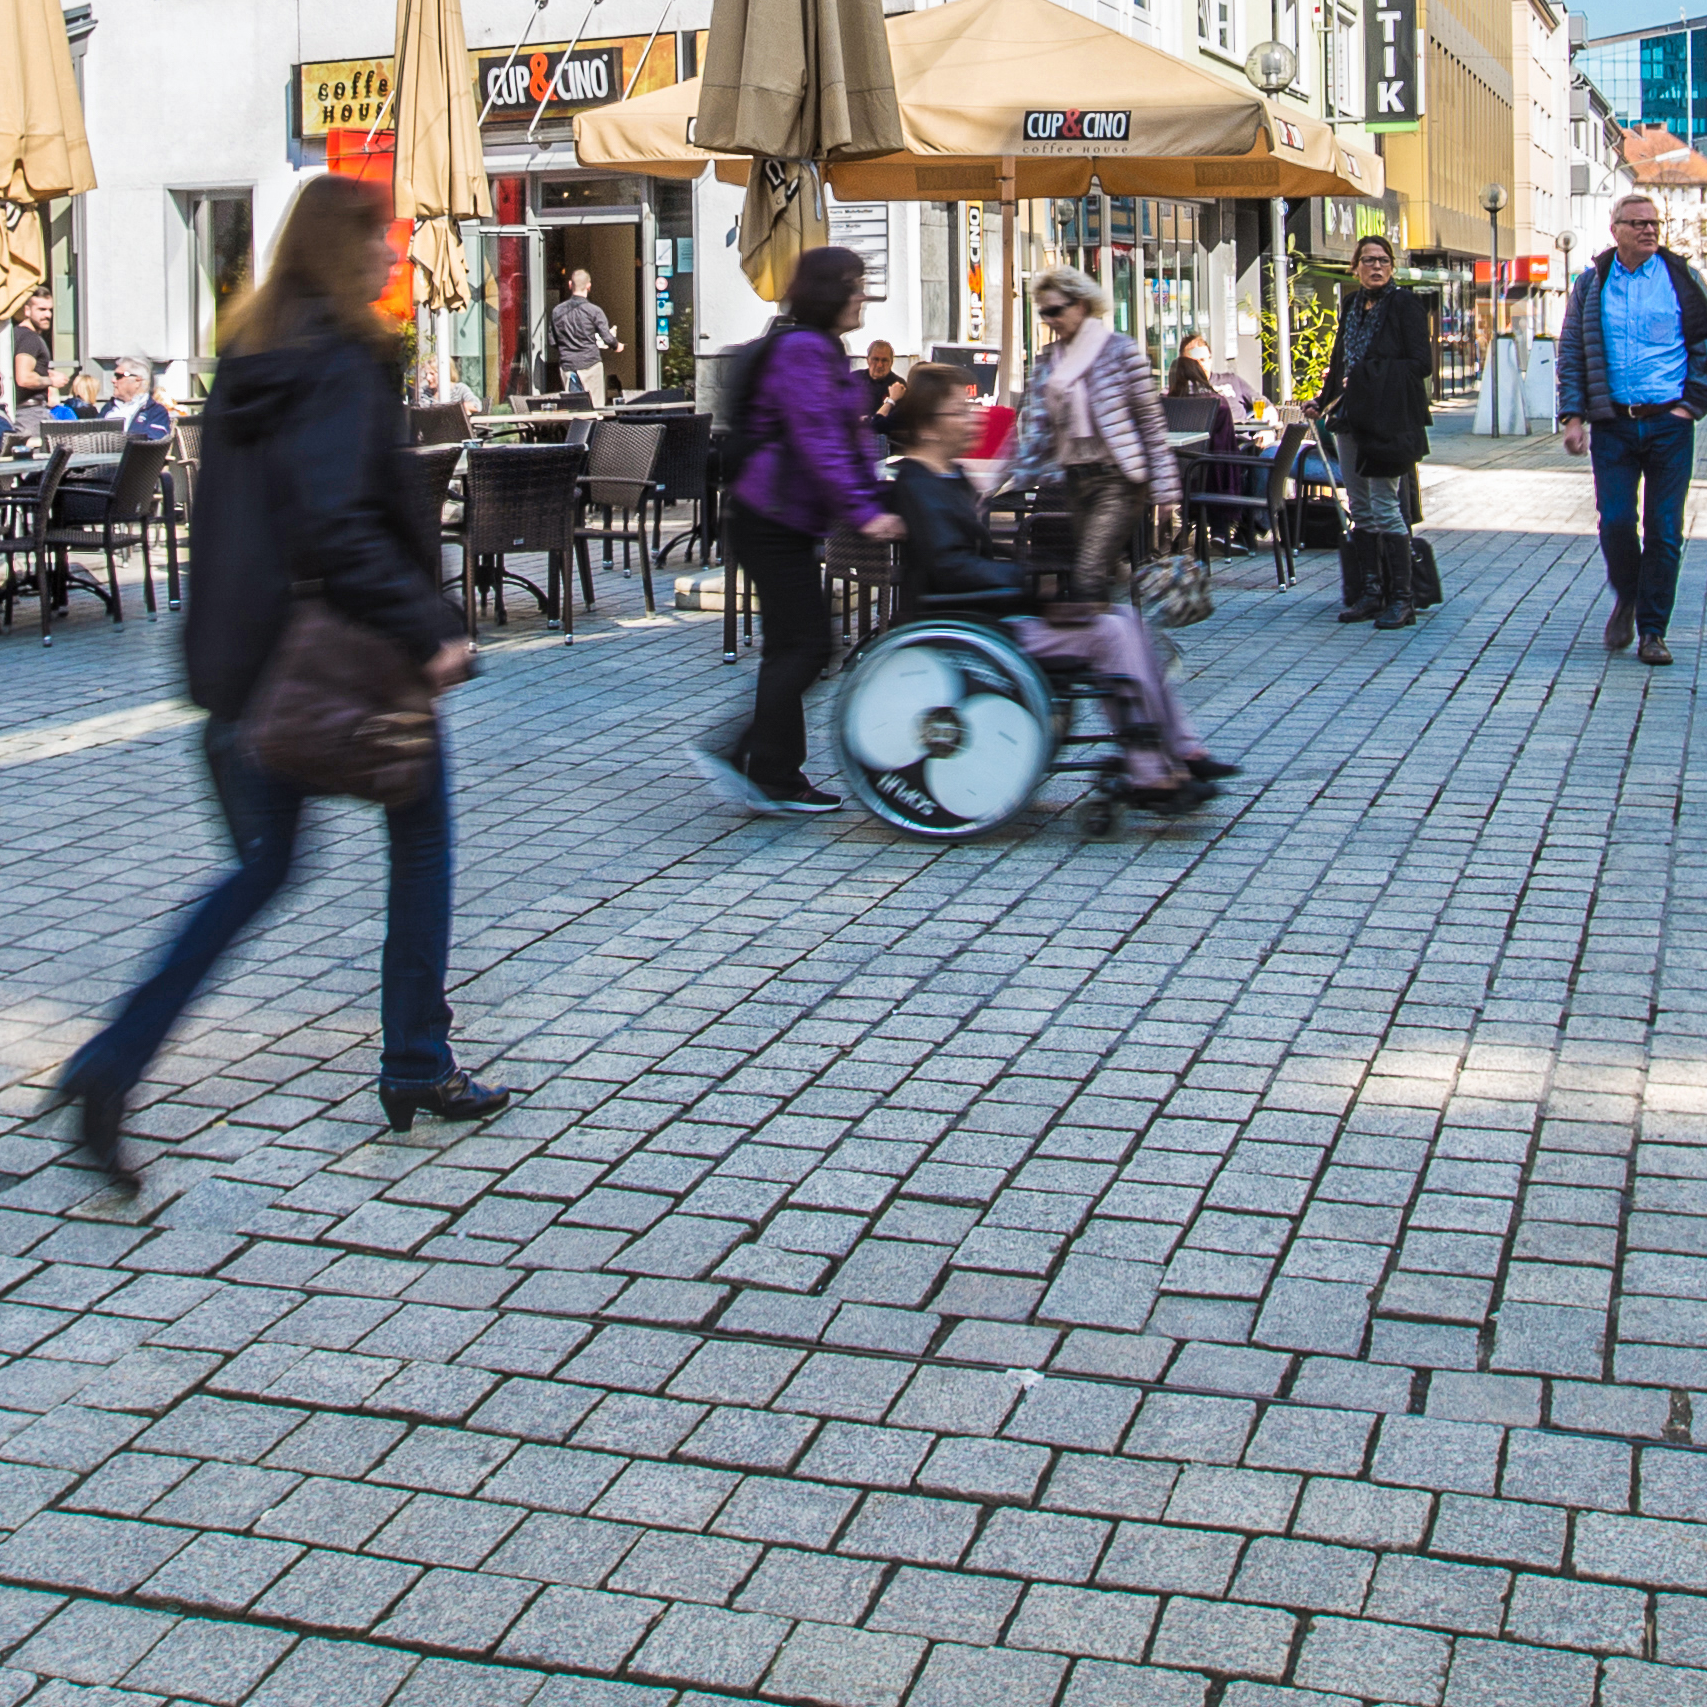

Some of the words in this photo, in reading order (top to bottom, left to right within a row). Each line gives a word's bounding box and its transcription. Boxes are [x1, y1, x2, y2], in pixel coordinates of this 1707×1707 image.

[317, 70, 389, 102] coffe
[1027, 108, 1130, 138] CUP&CINO
[1022, 143, 1074, 154] coffee
